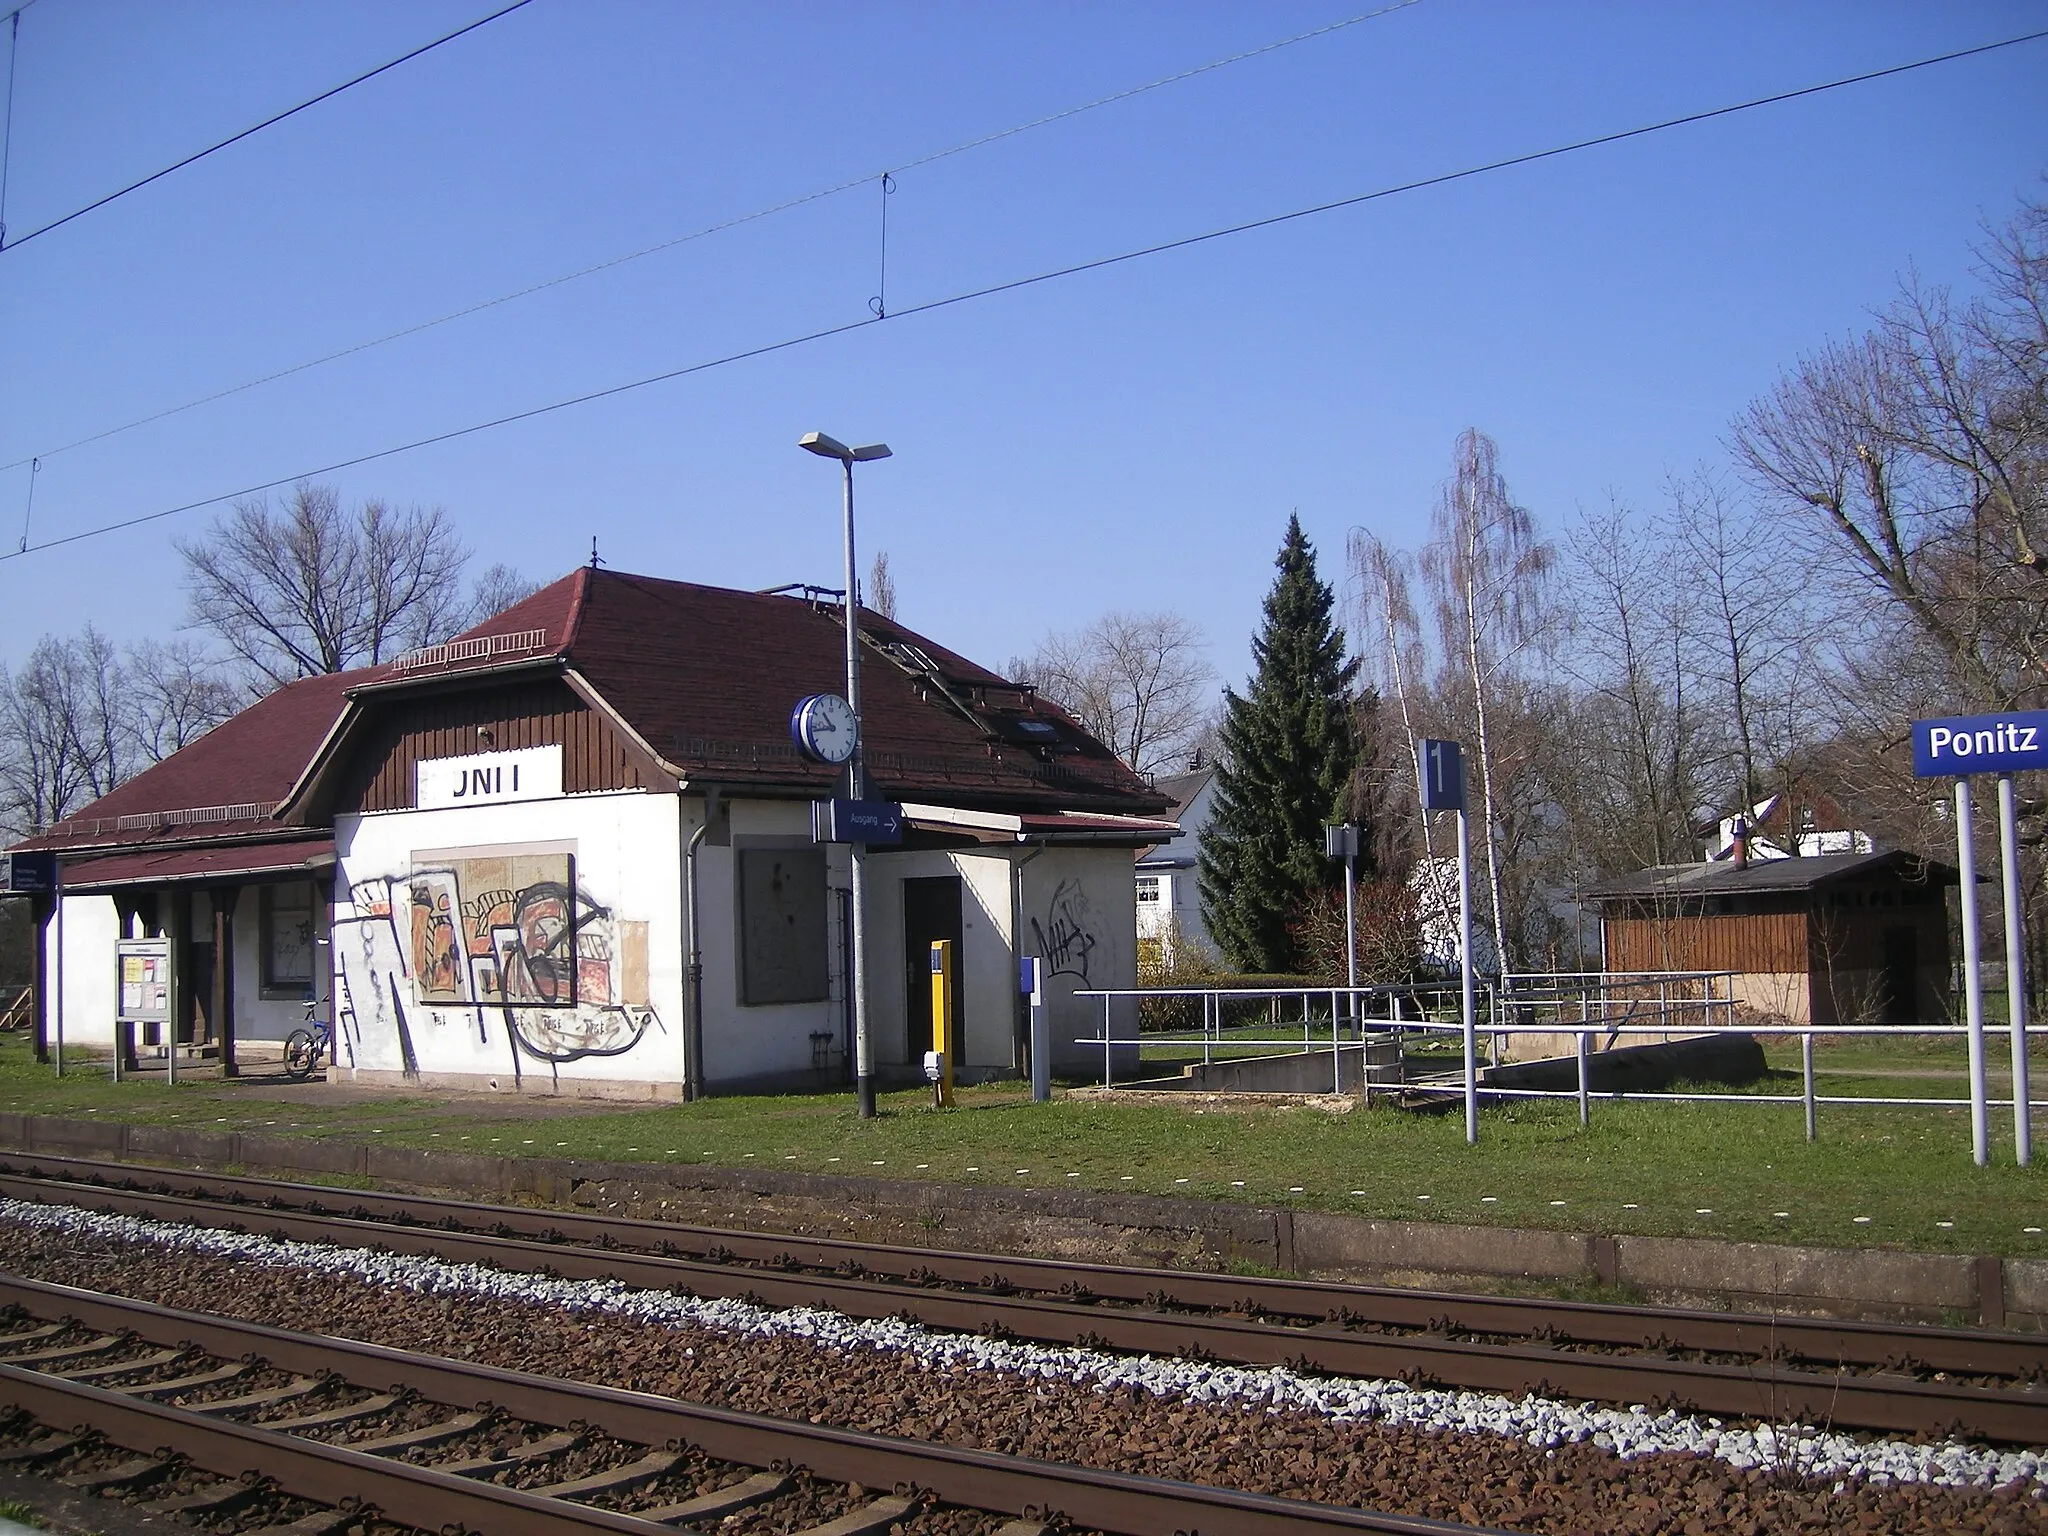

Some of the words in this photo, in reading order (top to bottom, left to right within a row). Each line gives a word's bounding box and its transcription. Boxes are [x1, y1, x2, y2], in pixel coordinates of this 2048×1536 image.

[1930, 723, 2039, 758] Ponitz
[1430, 742, 1443, 793] 1
[850, 812, 878, 825] Ausgang
